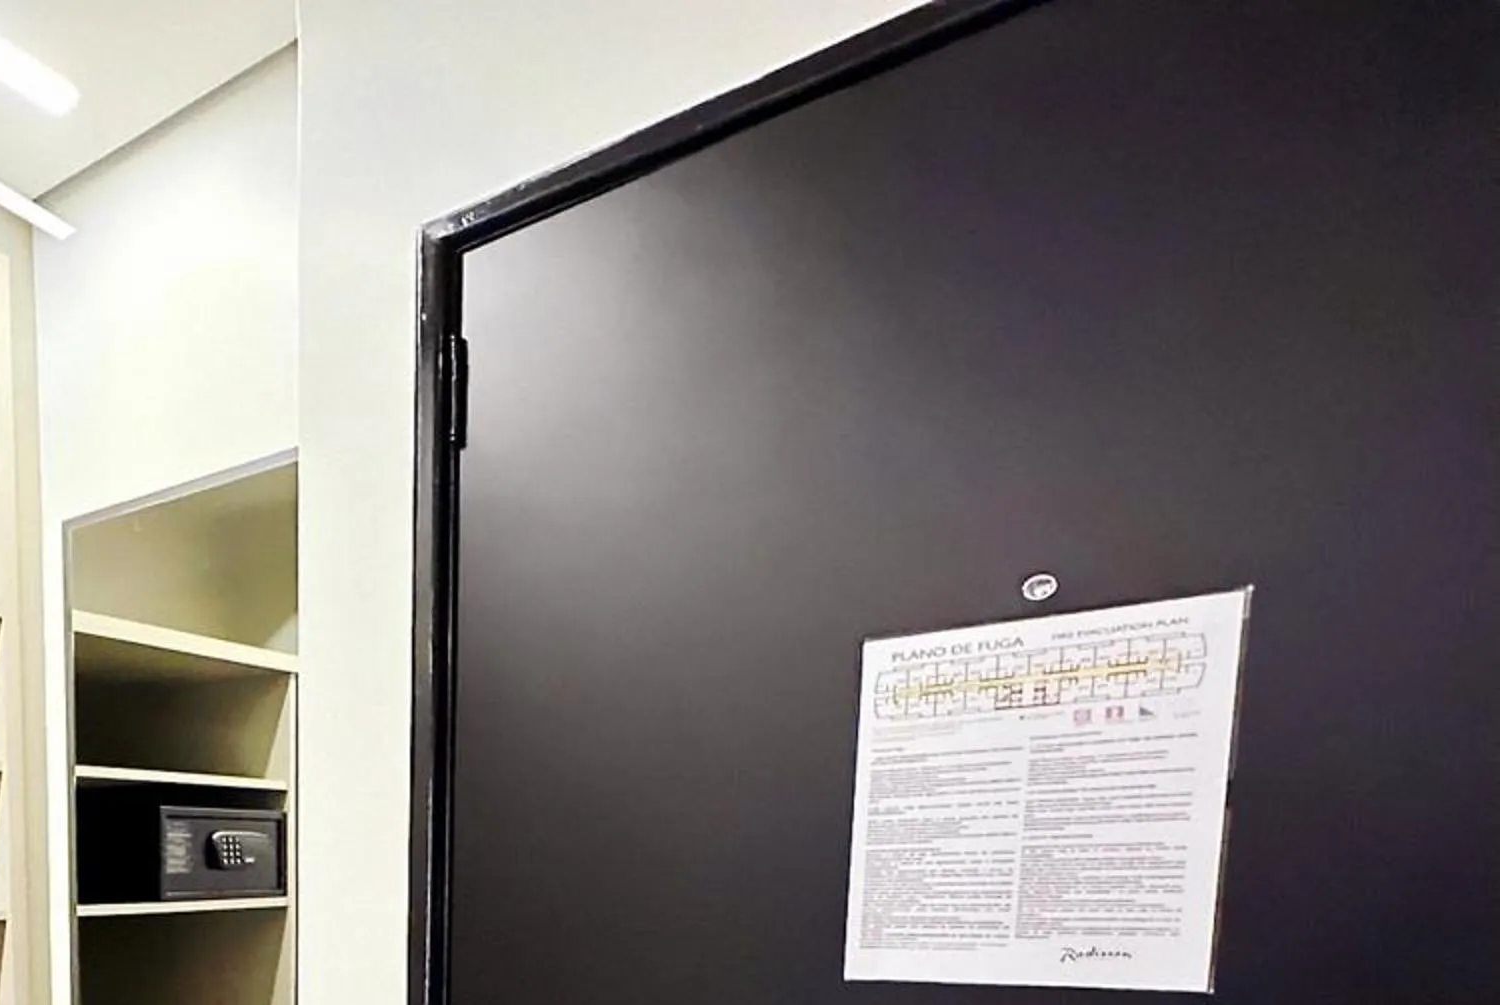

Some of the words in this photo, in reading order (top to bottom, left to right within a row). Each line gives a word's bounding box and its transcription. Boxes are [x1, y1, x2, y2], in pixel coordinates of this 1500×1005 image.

[891, 646, 947, 662] PLANO
[951, 642, 973, 655] DE
[977, 636, 1025, 652] FUGA
